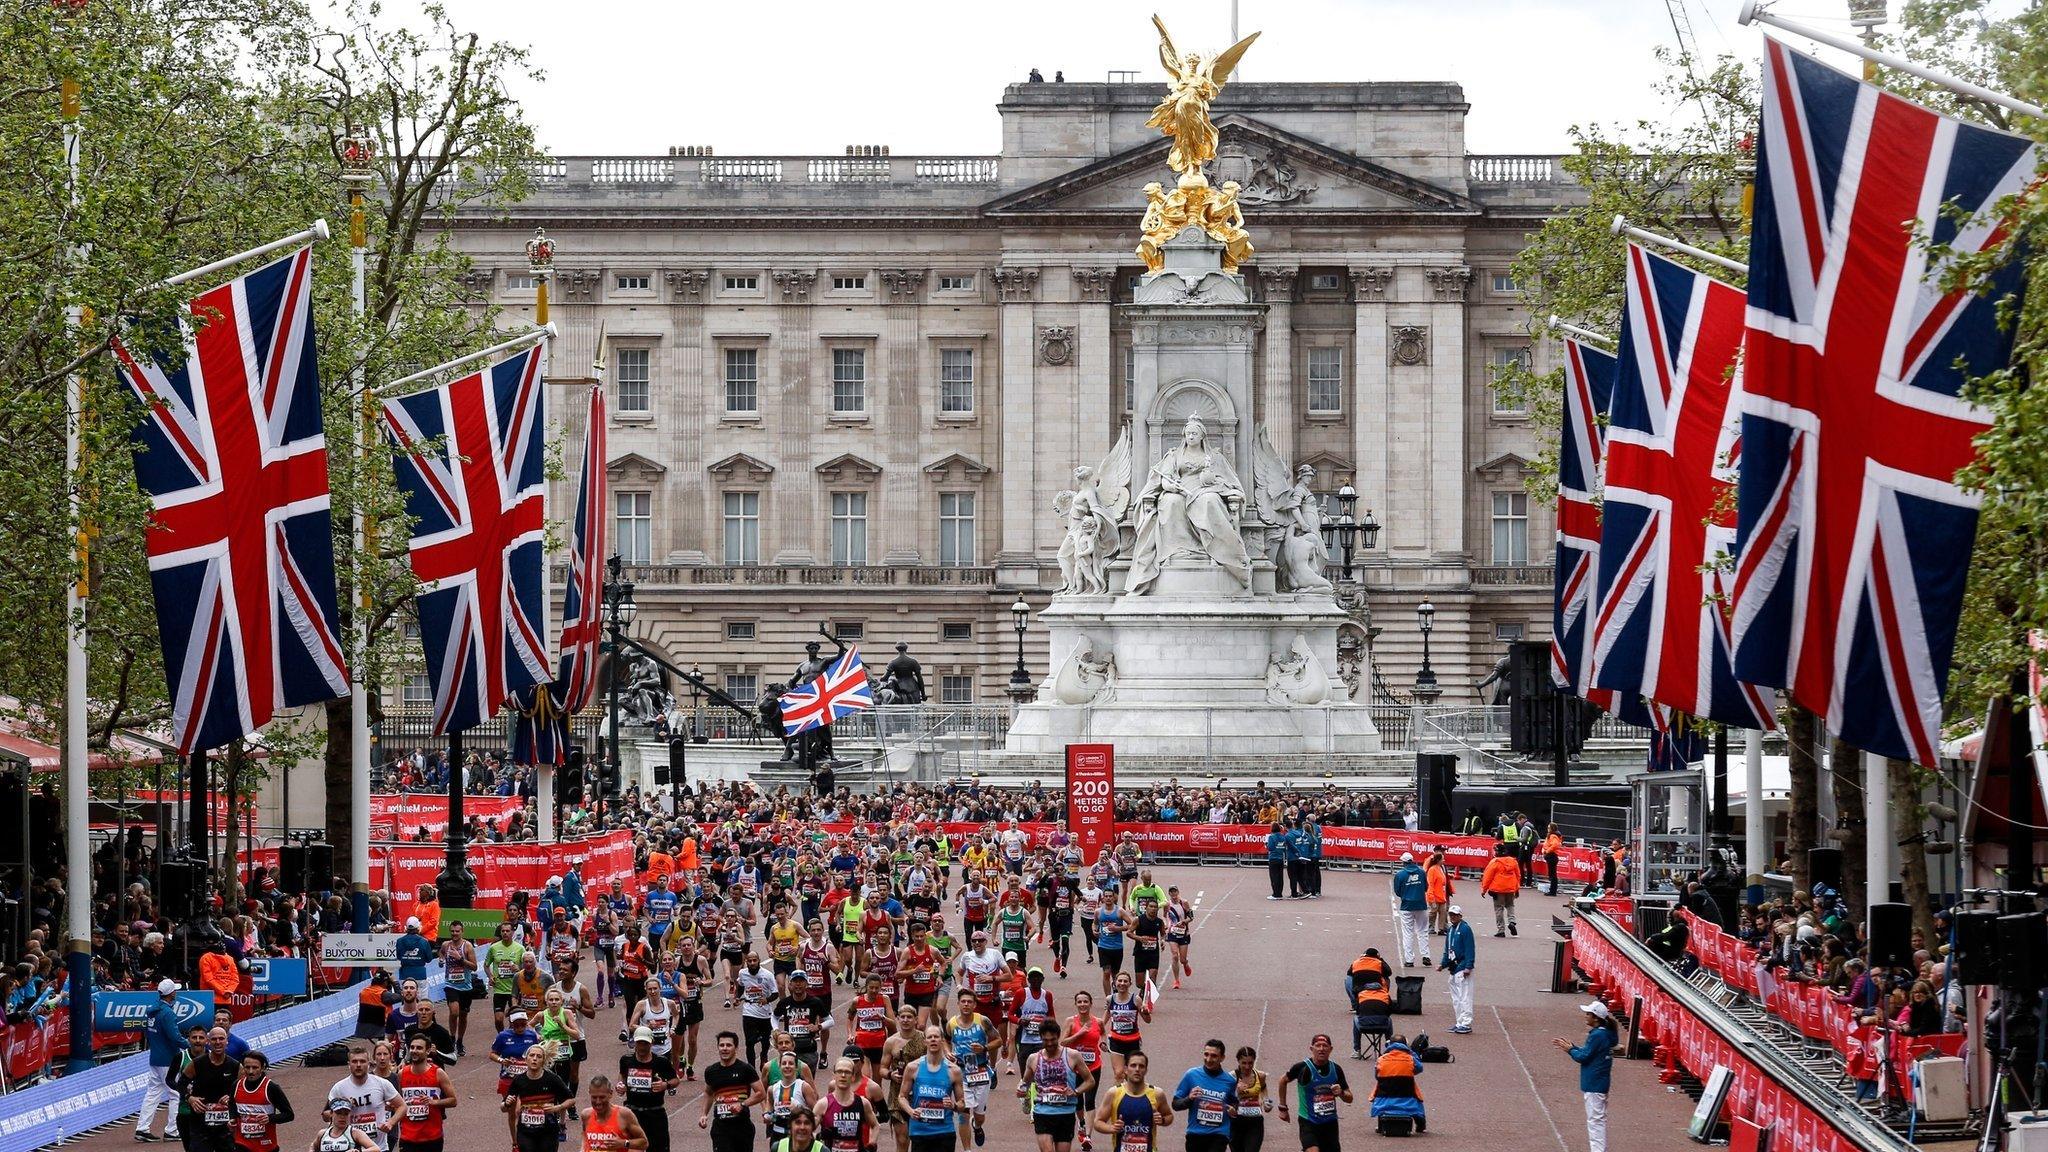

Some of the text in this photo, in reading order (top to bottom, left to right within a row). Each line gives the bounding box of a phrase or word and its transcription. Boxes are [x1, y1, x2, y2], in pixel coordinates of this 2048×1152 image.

[1072, 781, 1110, 796] 200
[1149, 832, 1185, 841] Marathon
[1223, 833, 1243, 844] Virgin
[1245, 834, 1267, 843] Mone
[1335, 837, 1355, 848] London
[1356, 838, 1385, 849] Marathon
[1411, 843, 1427, 852] Virgin
[1464, 848, 1489, 857] Marathon
[399, 857, 417, 870] virgin
[417, 858, 437, 869] money
[325, 949, 396, 957] BUXTON BUX
[805, 963, 823, 973] DAN
[953, 1025, 981, 1037] ARTHUR
[632, 1078, 649, 1086] 9368
[918, 1086, 946, 1096] GARETH
[833, 1111, 860, 1121] SIMON
